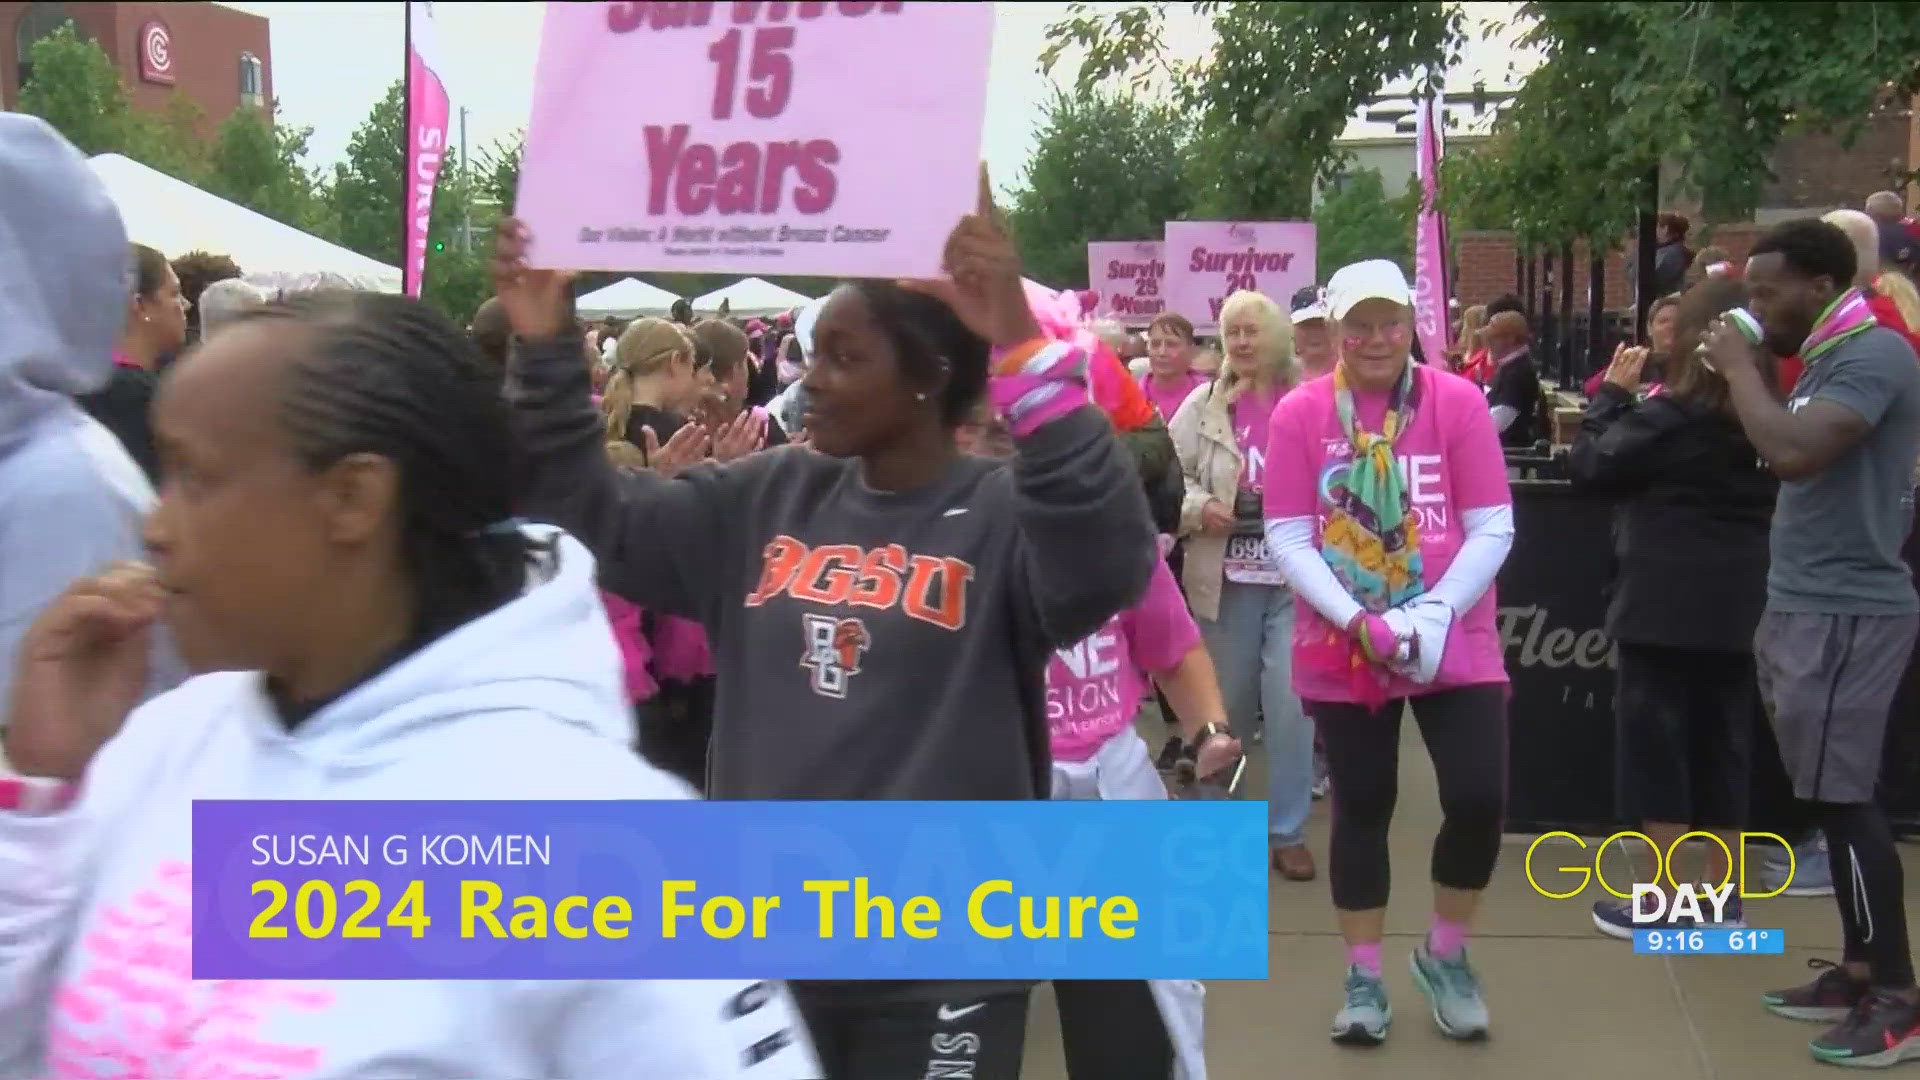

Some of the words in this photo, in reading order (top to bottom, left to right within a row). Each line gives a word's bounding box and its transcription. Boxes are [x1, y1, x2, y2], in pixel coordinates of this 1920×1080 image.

[707, 25, 796, 121] 15
[643, 124, 840, 216] Years
[1188, 246, 1295, 272] Survivor
[1225, 271, 1257, 294] 20
[744, 535, 975, 631] BGSU
